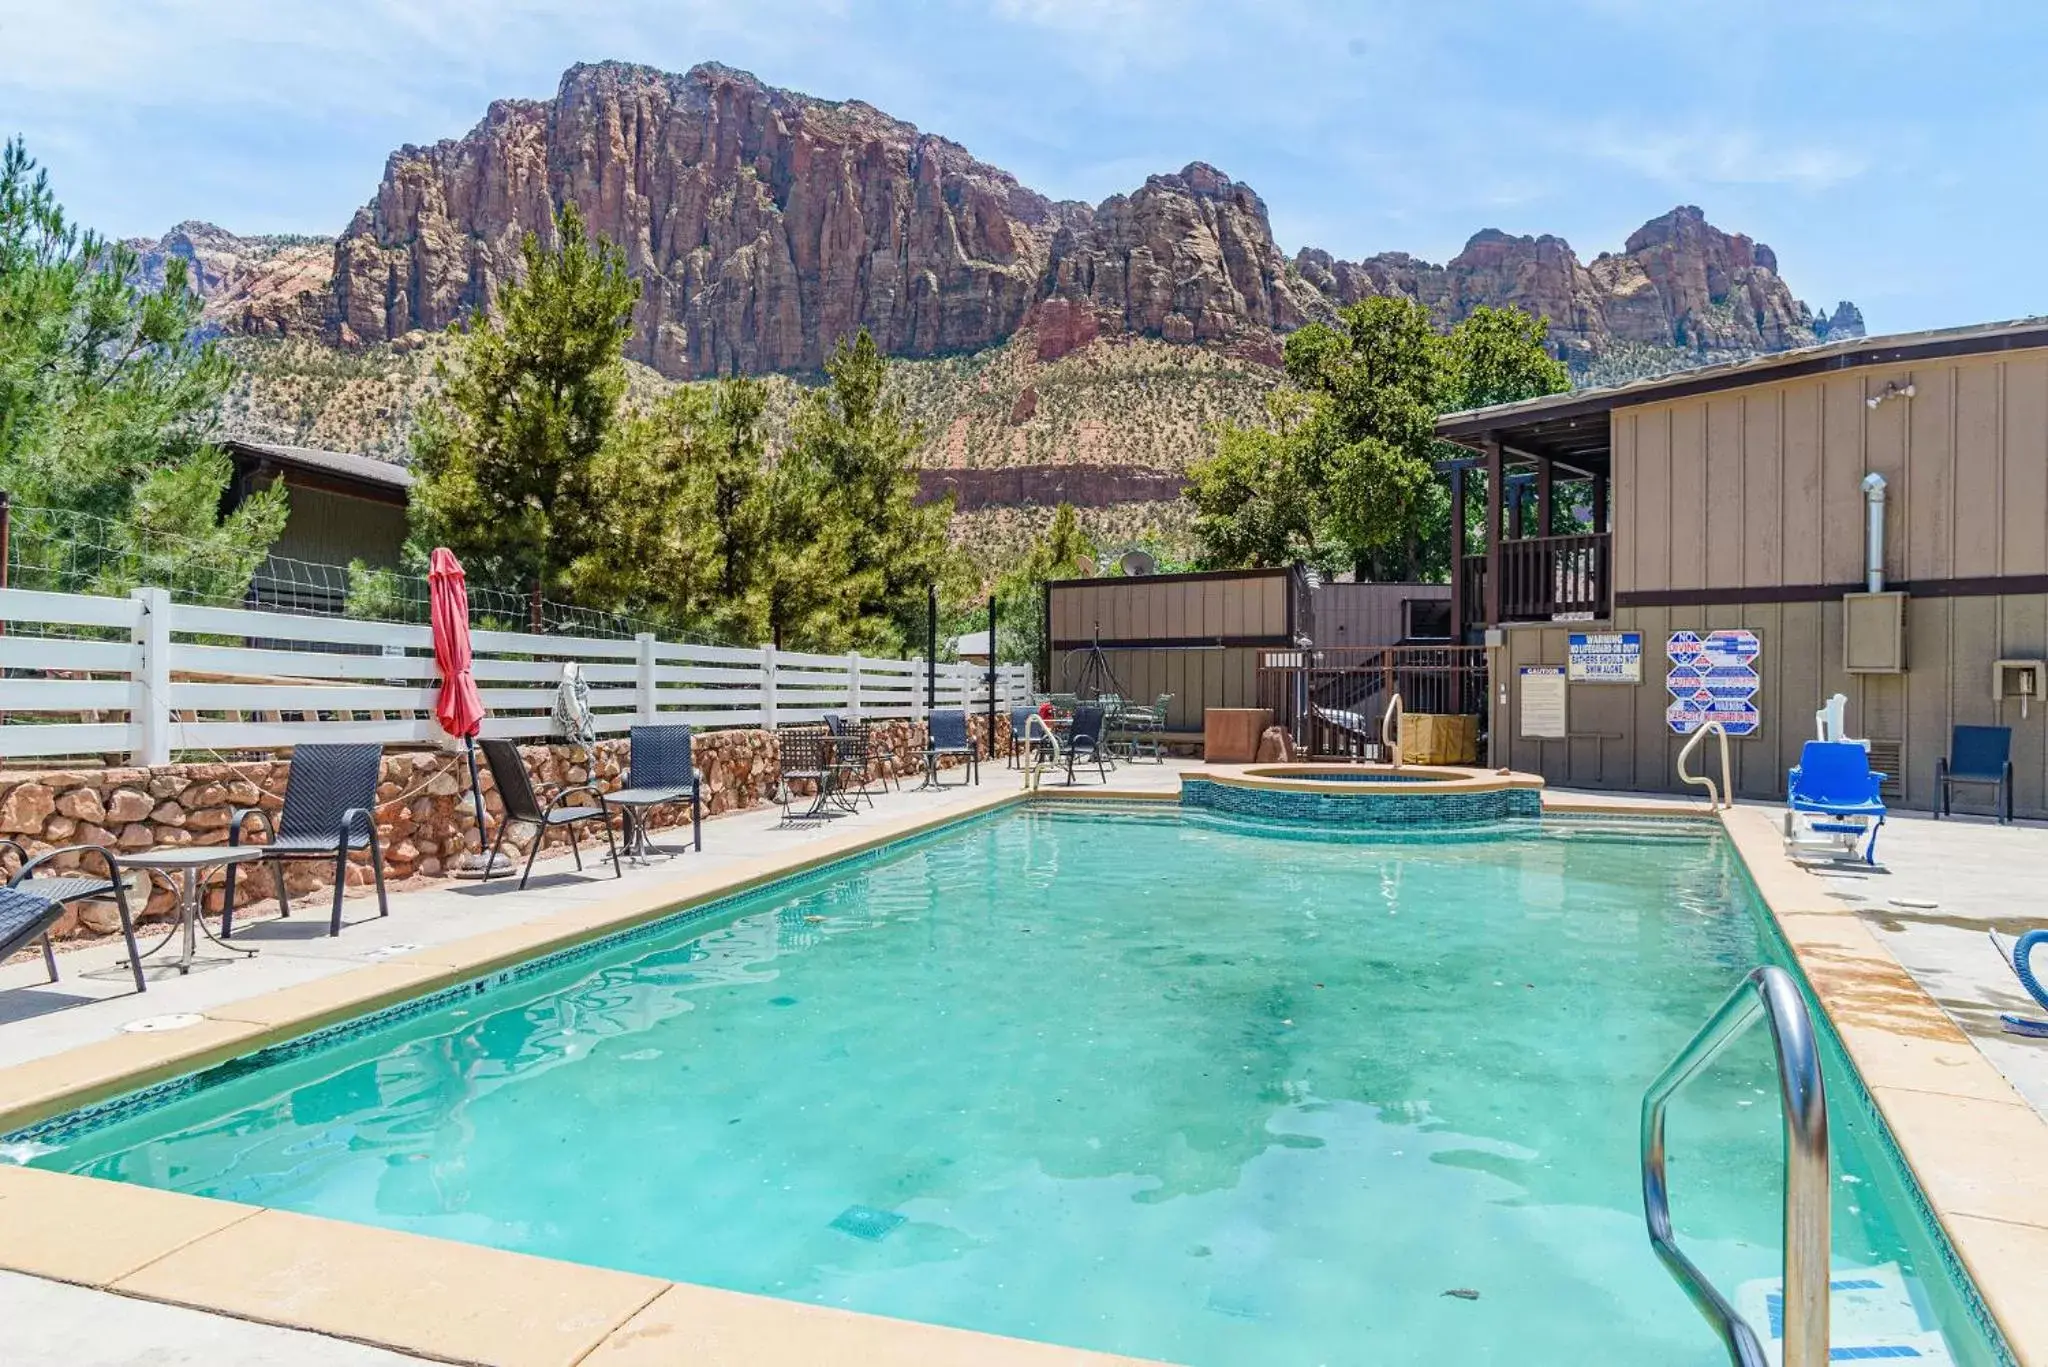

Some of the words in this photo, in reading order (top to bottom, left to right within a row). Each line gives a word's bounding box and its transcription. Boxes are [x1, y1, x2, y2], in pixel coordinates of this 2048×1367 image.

[1587, 634, 1623, 644] WARNING
[1679, 633, 1693, 642] NO
[1571, 644, 1579, 653] NO
[1580, 644, 1612, 653] LIFEGUARD
[1613, 644, 1622, 653] ON
[1623, 644, 1639, 653] DUTY
[1669, 643, 1701, 652] DIVING
[1572, 655, 1598, 665] BATHERS
[1599, 655, 1624, 665] SHOULD
[1625, 655, 1639, 665] NOT
[1527, 667, 1559, 675] CAUTION
[1585, 665, 1602, 674] SWIM
[1603, 665, 1623, 674] ALONE
[1669, 677, 1701, 686] CAUTION
[1669, 711, 1701, 721] CAPACITY
